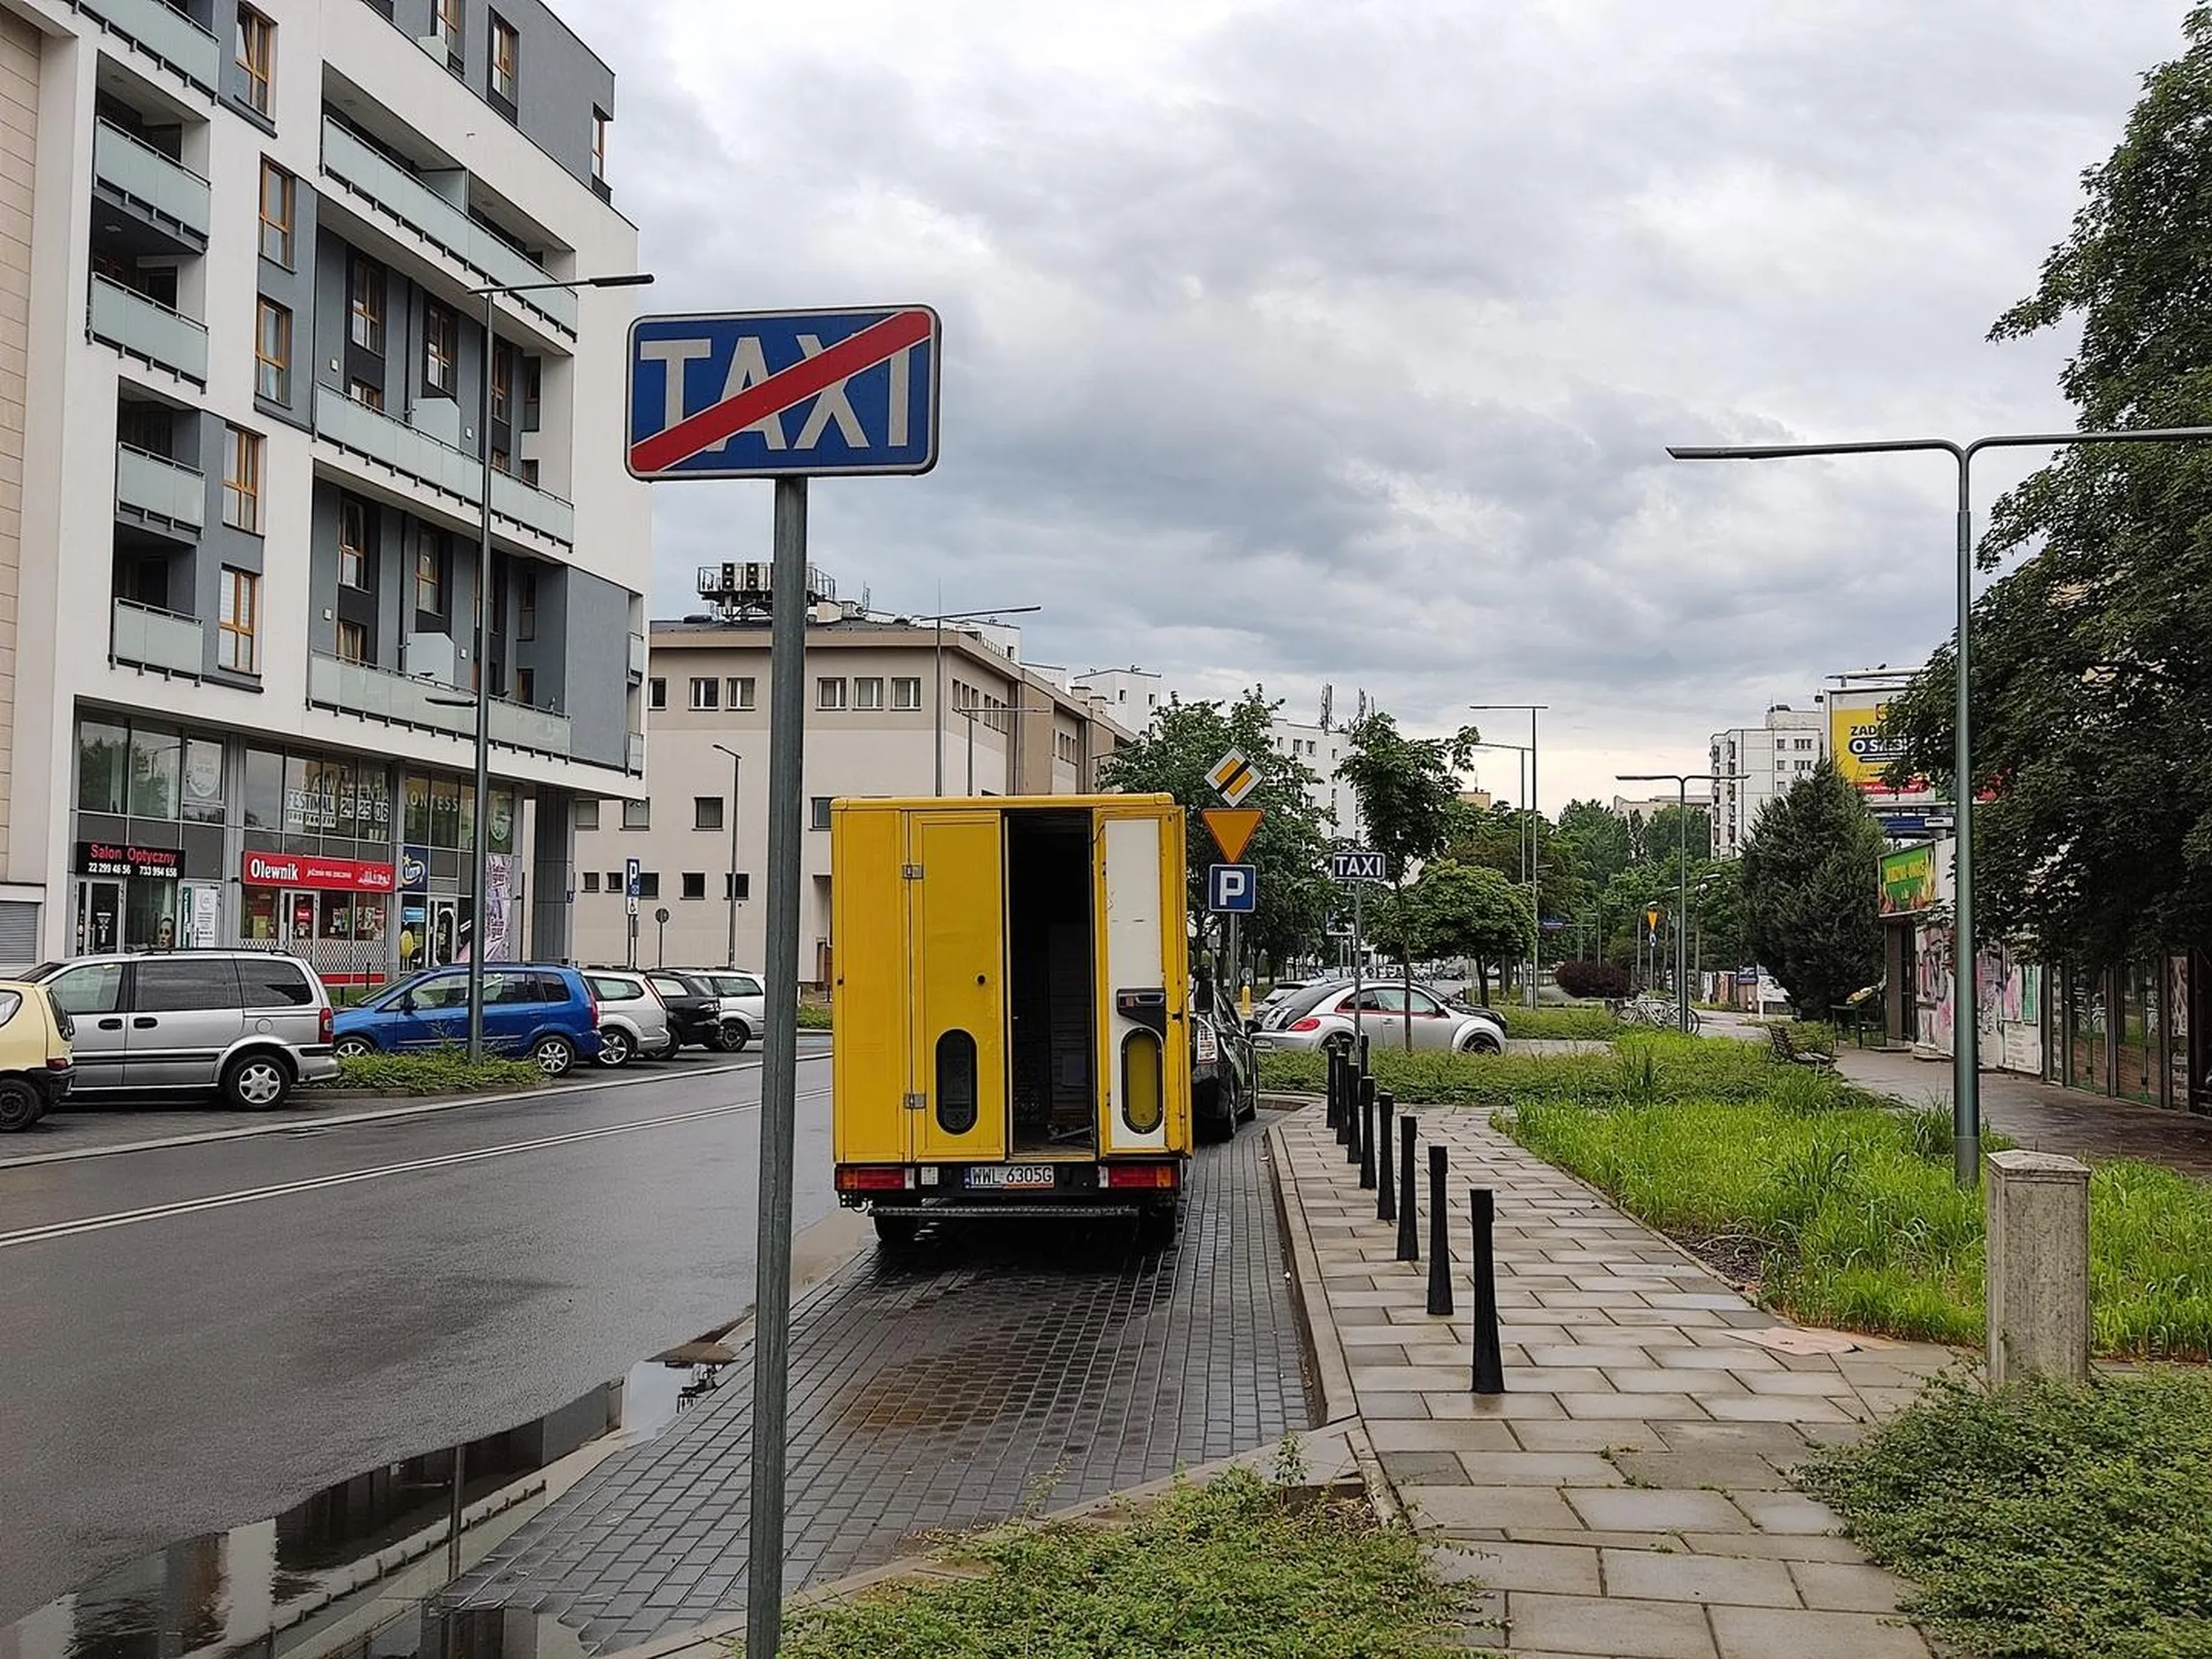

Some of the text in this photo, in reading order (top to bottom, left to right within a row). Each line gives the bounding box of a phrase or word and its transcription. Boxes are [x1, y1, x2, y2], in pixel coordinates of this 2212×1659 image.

[640, 334, 910, 452] TAXI
[1850, 726, 1878, 736] ZAD
[1852, 740, 1866, 752] O
[90, 844, 176, 866] Salon Optyczny
[88, 862, 97, 873] 22
[250, 858, 298, 881] Olewnik
[629, 861, 638, 886] P
[1335, 856, 1381, 876] TAXI
[1219, 871, 1245, 906] P
[973, 1167, 1052, 1184] WWL 6305G
